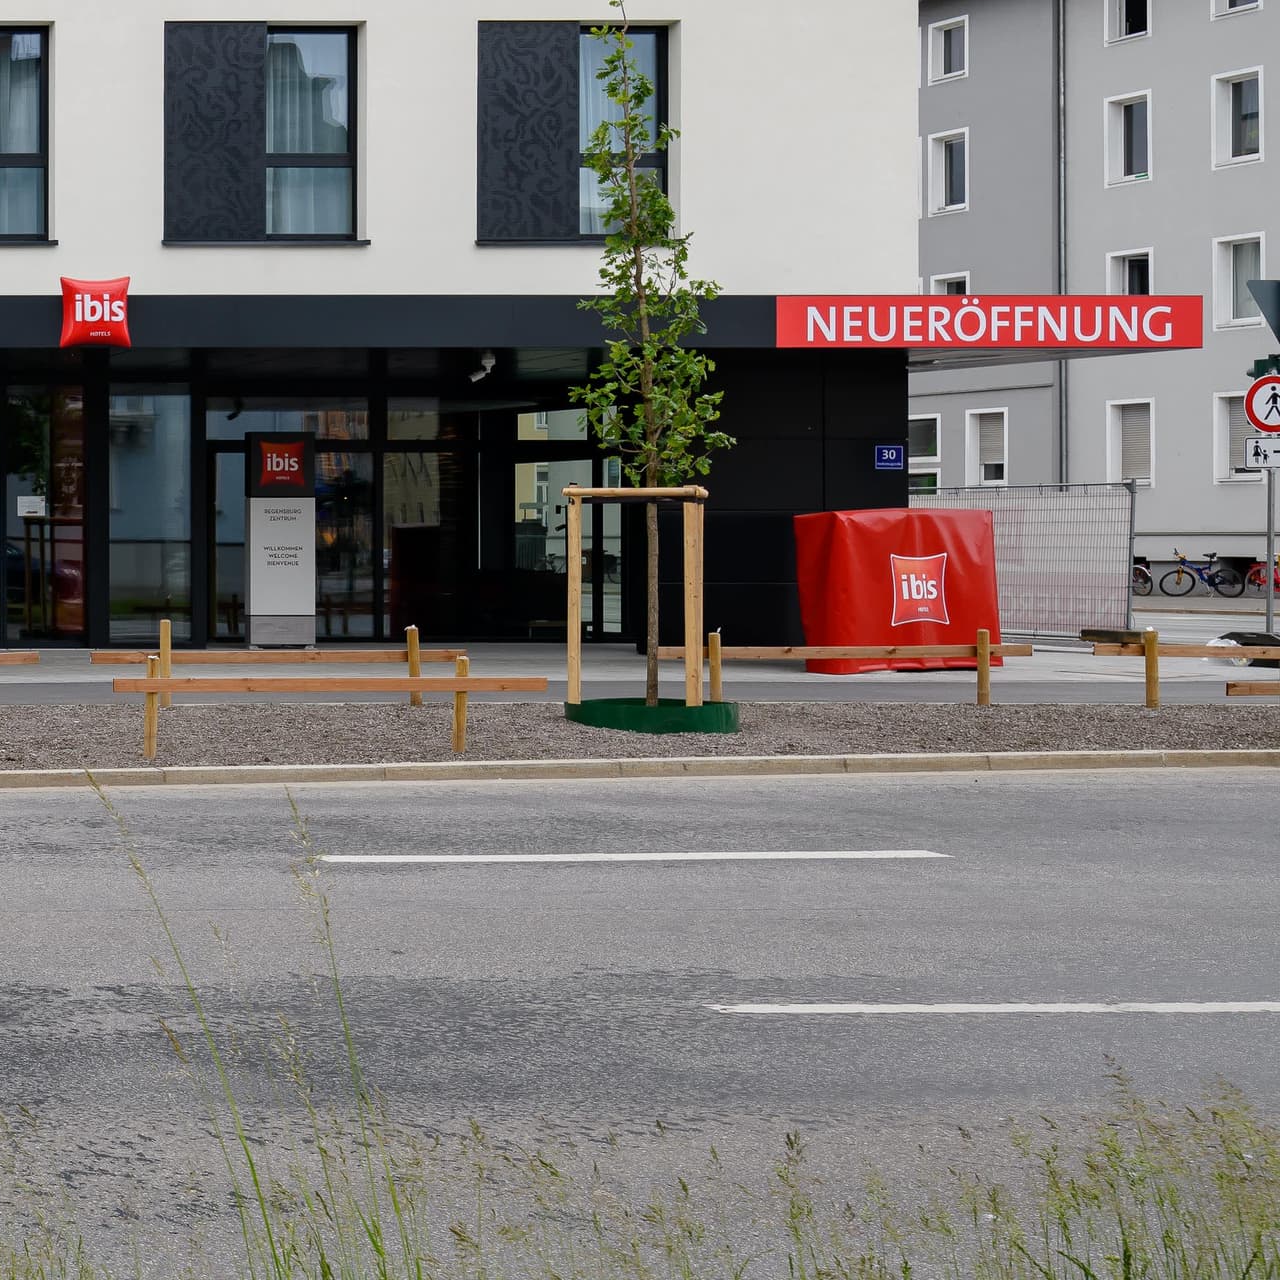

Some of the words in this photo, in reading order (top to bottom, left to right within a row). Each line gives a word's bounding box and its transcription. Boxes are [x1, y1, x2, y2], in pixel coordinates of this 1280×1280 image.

[74, 293, 125, 322] ibis
[806, 297, 1173, 342] NEUERÖFFNUNG
[266, 453, 299, 471] ibis
[882, 449, 896, 460] 30
[901, 573, 938, 600] ibis
